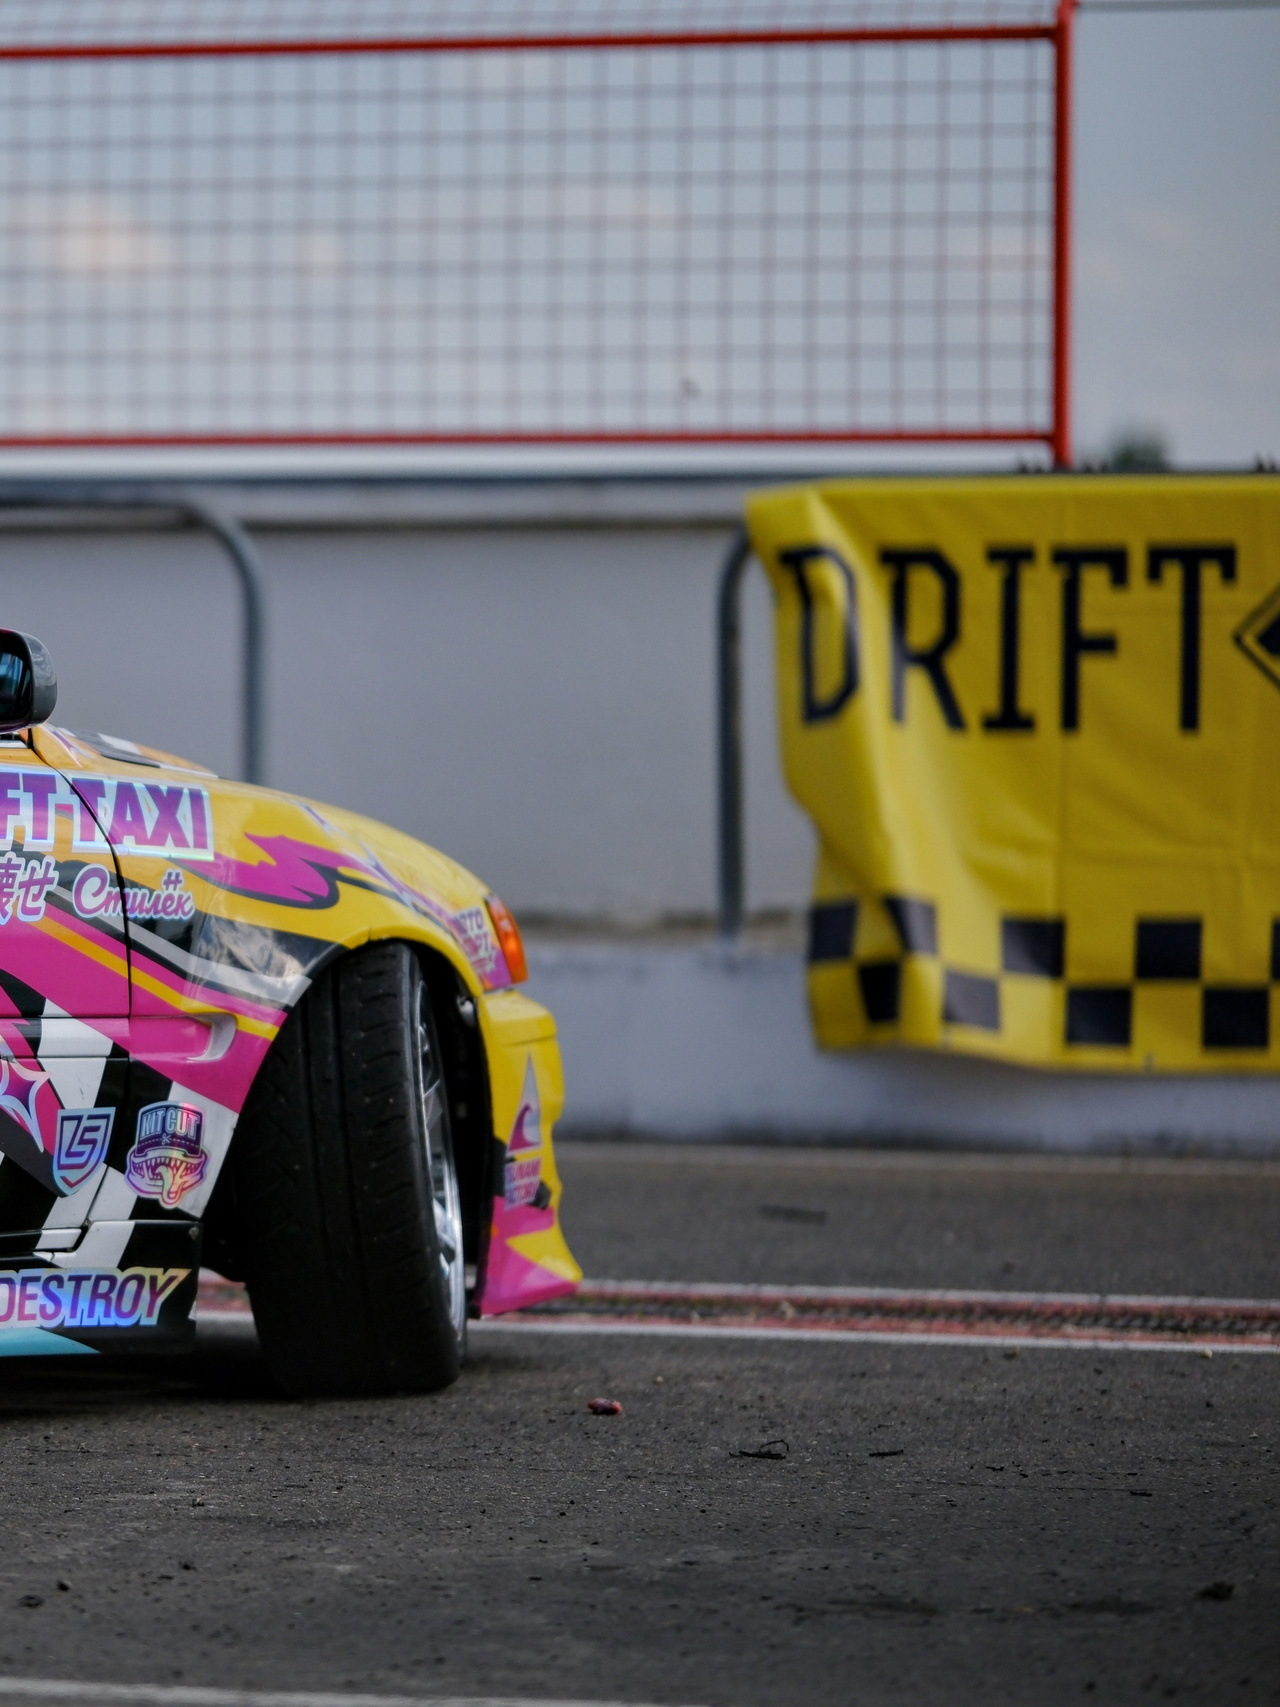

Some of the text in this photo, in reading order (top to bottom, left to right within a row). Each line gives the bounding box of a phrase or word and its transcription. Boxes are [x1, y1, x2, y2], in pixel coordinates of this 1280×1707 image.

[778, 541, 1237, 734] DRIFT
[70, 777, 208, 850] TAXI
[140, 1107, 200, 1140] KIT CUT
